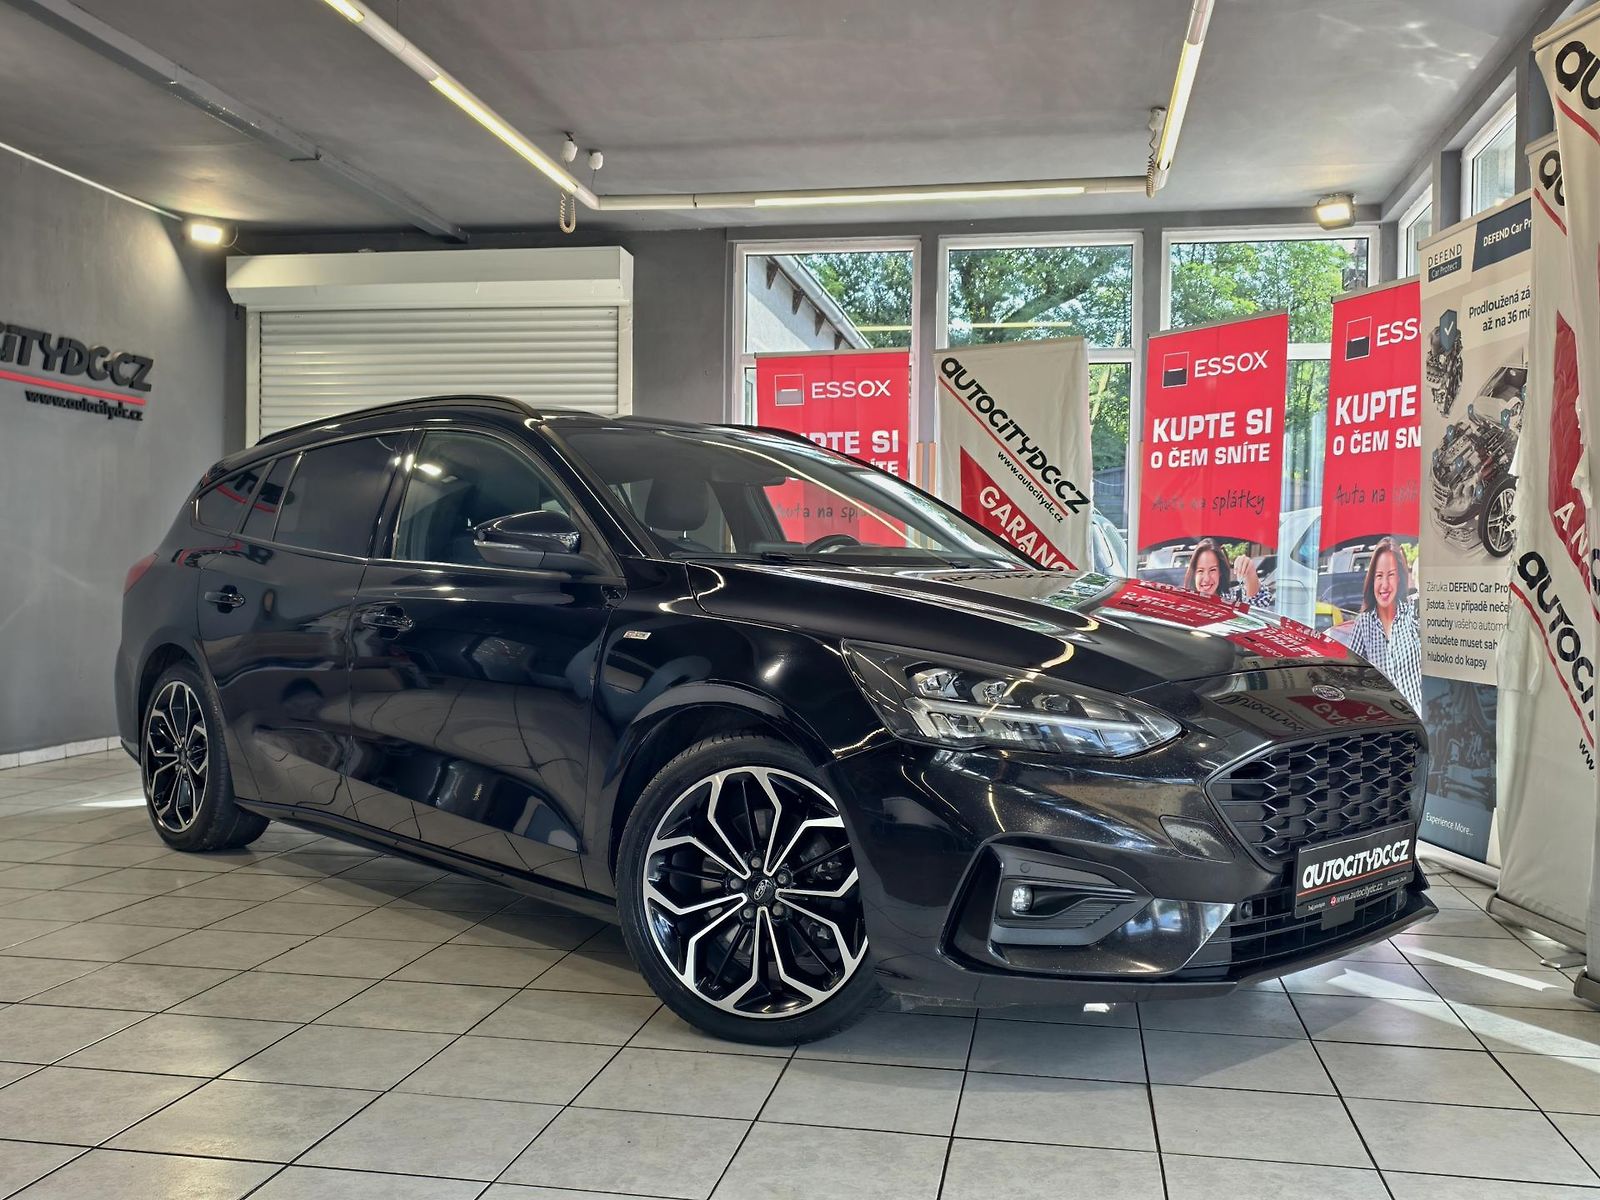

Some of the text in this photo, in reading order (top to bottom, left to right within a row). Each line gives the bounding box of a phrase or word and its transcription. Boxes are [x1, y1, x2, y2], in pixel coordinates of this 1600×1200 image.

[1483, 228, 1510, 246] DEFEND
[1511, 222, 1522, 234] Car
[1428, 243, 1462, 268] DEFEND
[1431, 261, 1458, 279] Car Protect
[1469, 290, 1519, 318] Prodloužená
[1483, 316, 1493, 331] až
[1495, 317, 1506, 328] na
[1508, 309, 1517, 324] 36
[1376, 317, 1421, 347] ESS
[1194, 350, 1269, 378] ESSOX
[811, 380, 891, 399] ESSOX
[1335, 385, 1417, 426] KUPTE
[1153, 407, 1273, 443] KUPTE SI
[871, 430, 899, 453] SI
[1332, 435, 1345, 456] O
[1350, 429, 1389, 454] ČEM
[1150, 441, 1270, 469] O ČEM SNÍTE
[998, 451, 1064, 523] www.autocitydc.cz
[1335, 483, 1365, 505] Auta
[1372, 488, 1385, 504] na
[817, 506, 833, 518] na
[1212, 489, 1265, 516] splátky
[1449, 582, 1477, 593] DEFEND
[1479, 582, 1492, 593] Car
[1494, 582, 1508, 593] Pro
[1461, 601, 1488, 613] případě
[1427, 618, 1453, 631] poruchy
[1455, 619, 1477, 630] vašeho
[1427, 635, 1459, 647] nebudete
[1460, 637, 1483, 649] muset
[1427, 652, 1487, 670] hluboko do kapsy
[1426, 812, 1454, 829] Experience
